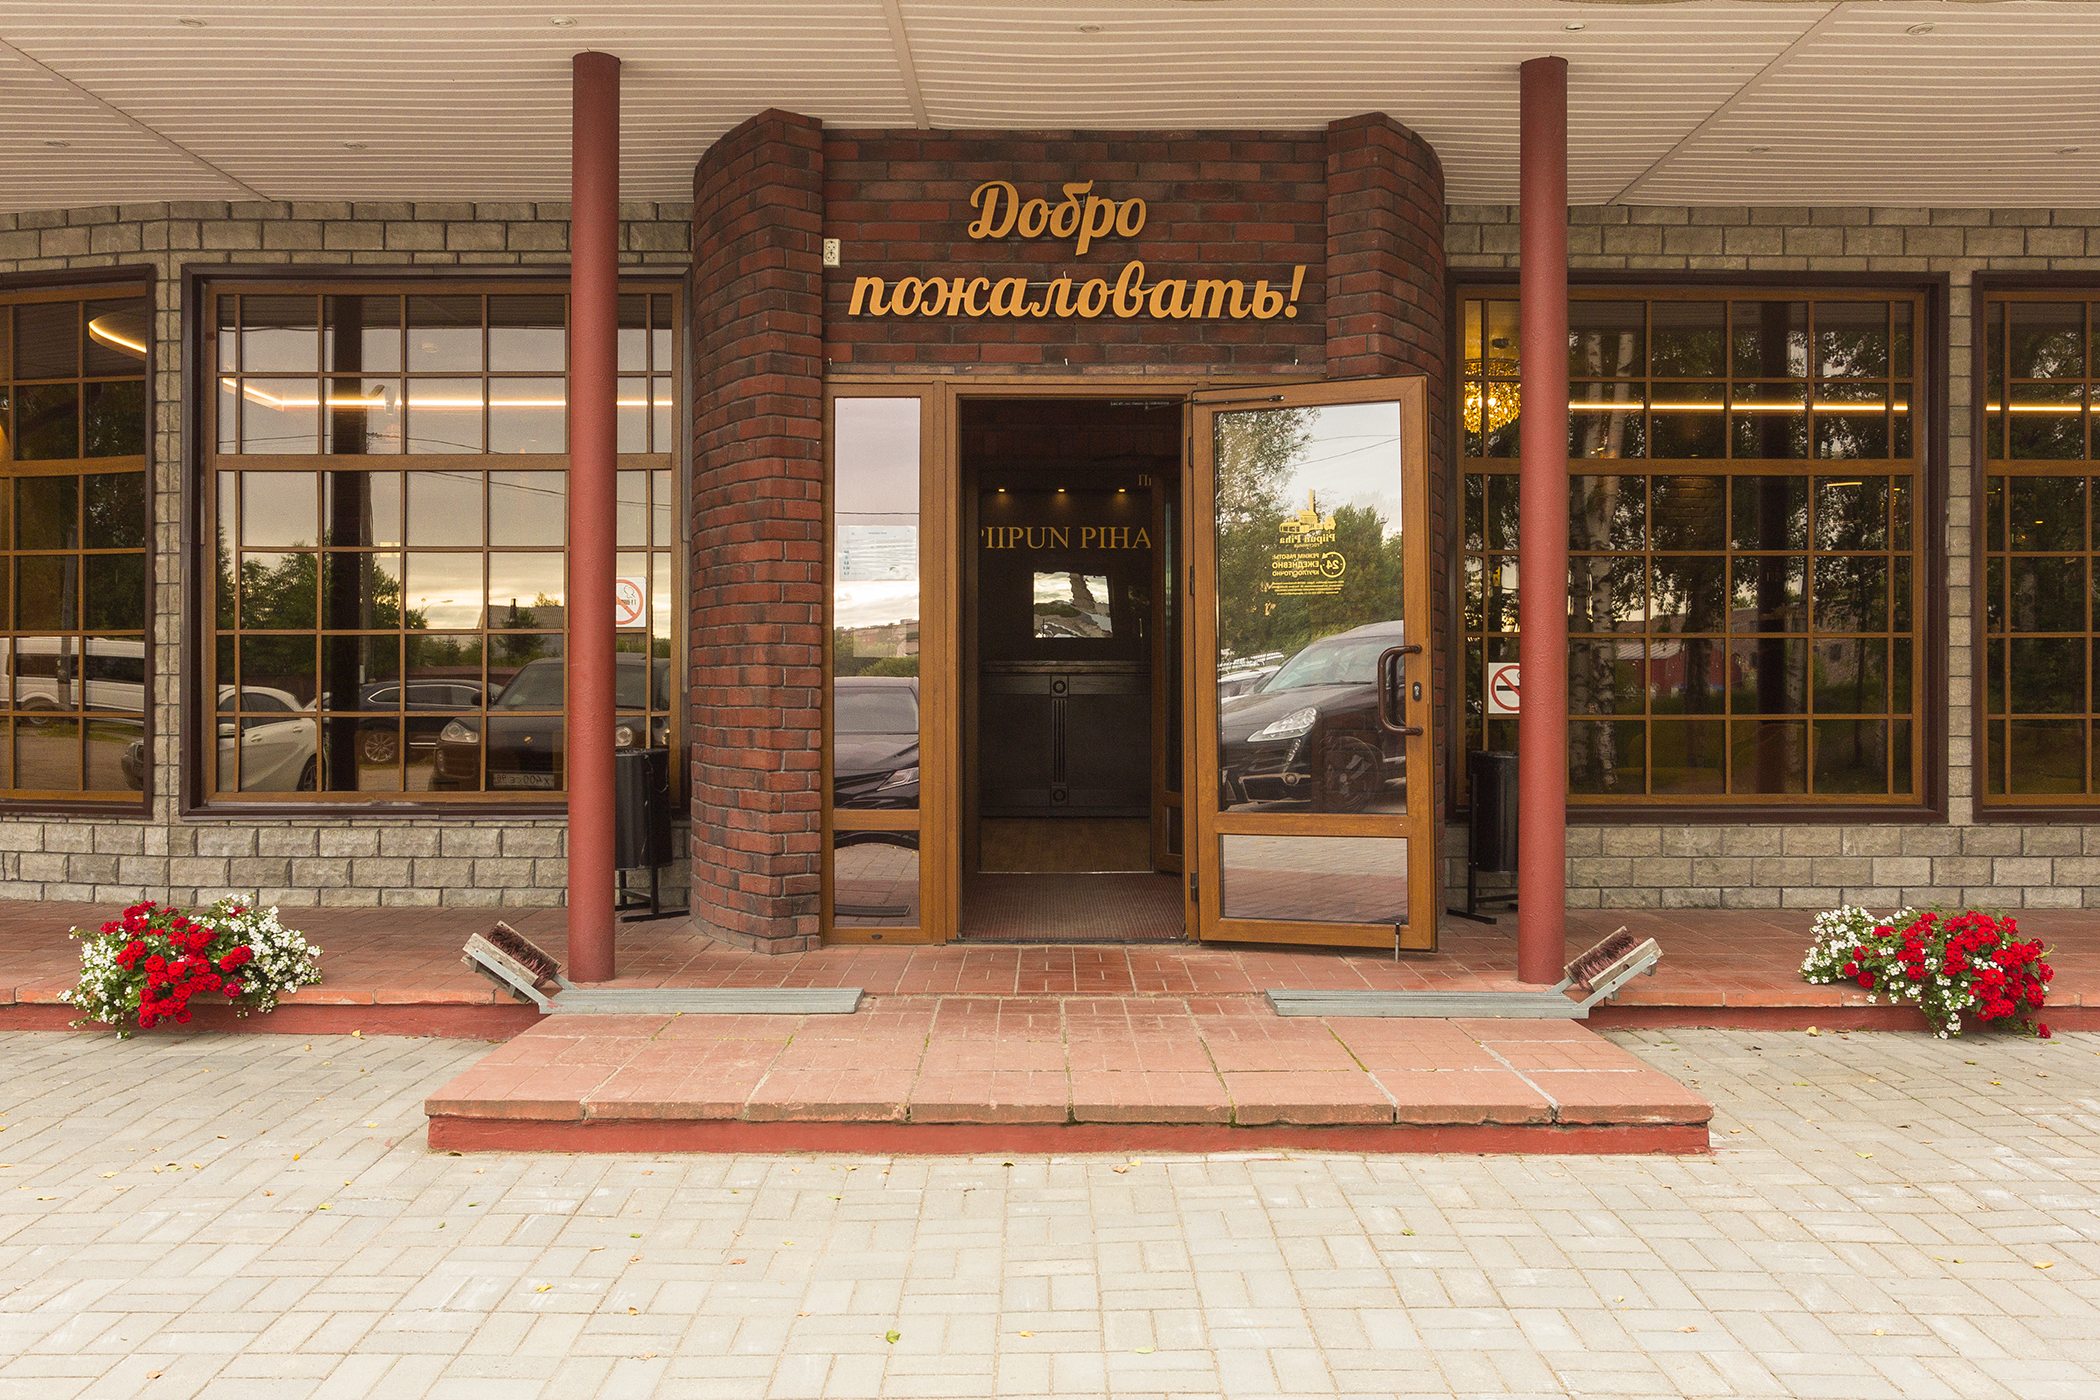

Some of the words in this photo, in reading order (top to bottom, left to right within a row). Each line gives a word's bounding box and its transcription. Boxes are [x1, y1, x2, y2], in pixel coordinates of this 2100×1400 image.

[967, 180, 1147, 256] Добро
[848, 260, 1307, 319] пожаловать!
[981, 526, 1070, 549] IIPUN
[1079, 526, 1152, 549] PIHA
